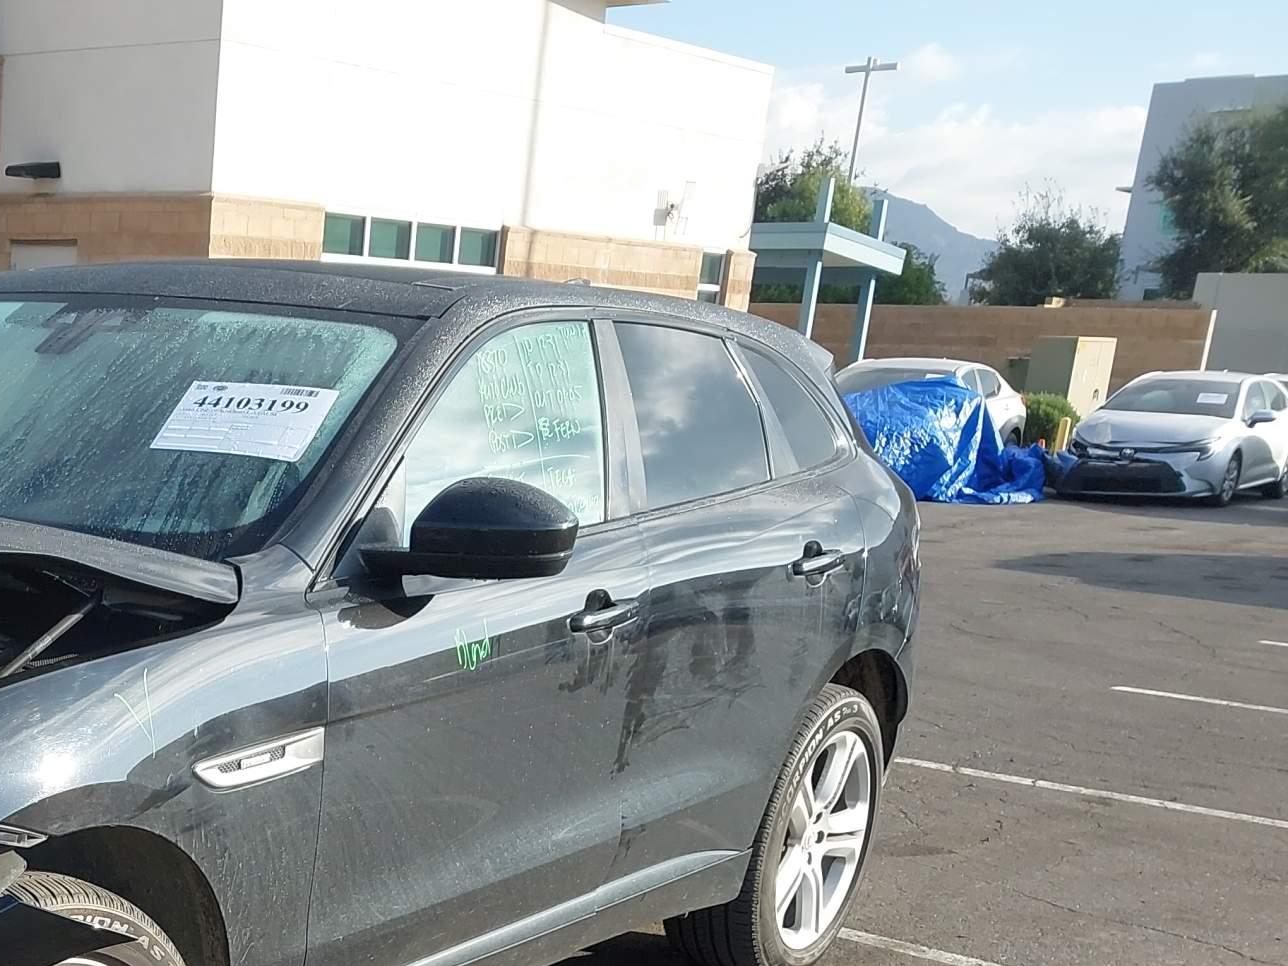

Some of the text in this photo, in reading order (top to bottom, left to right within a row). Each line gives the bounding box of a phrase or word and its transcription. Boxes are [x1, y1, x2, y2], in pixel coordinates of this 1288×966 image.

[192, 395, 310, 414] 44103199
[826, 710, 841, 731] AS
[137, 935, 166, 962] AS
